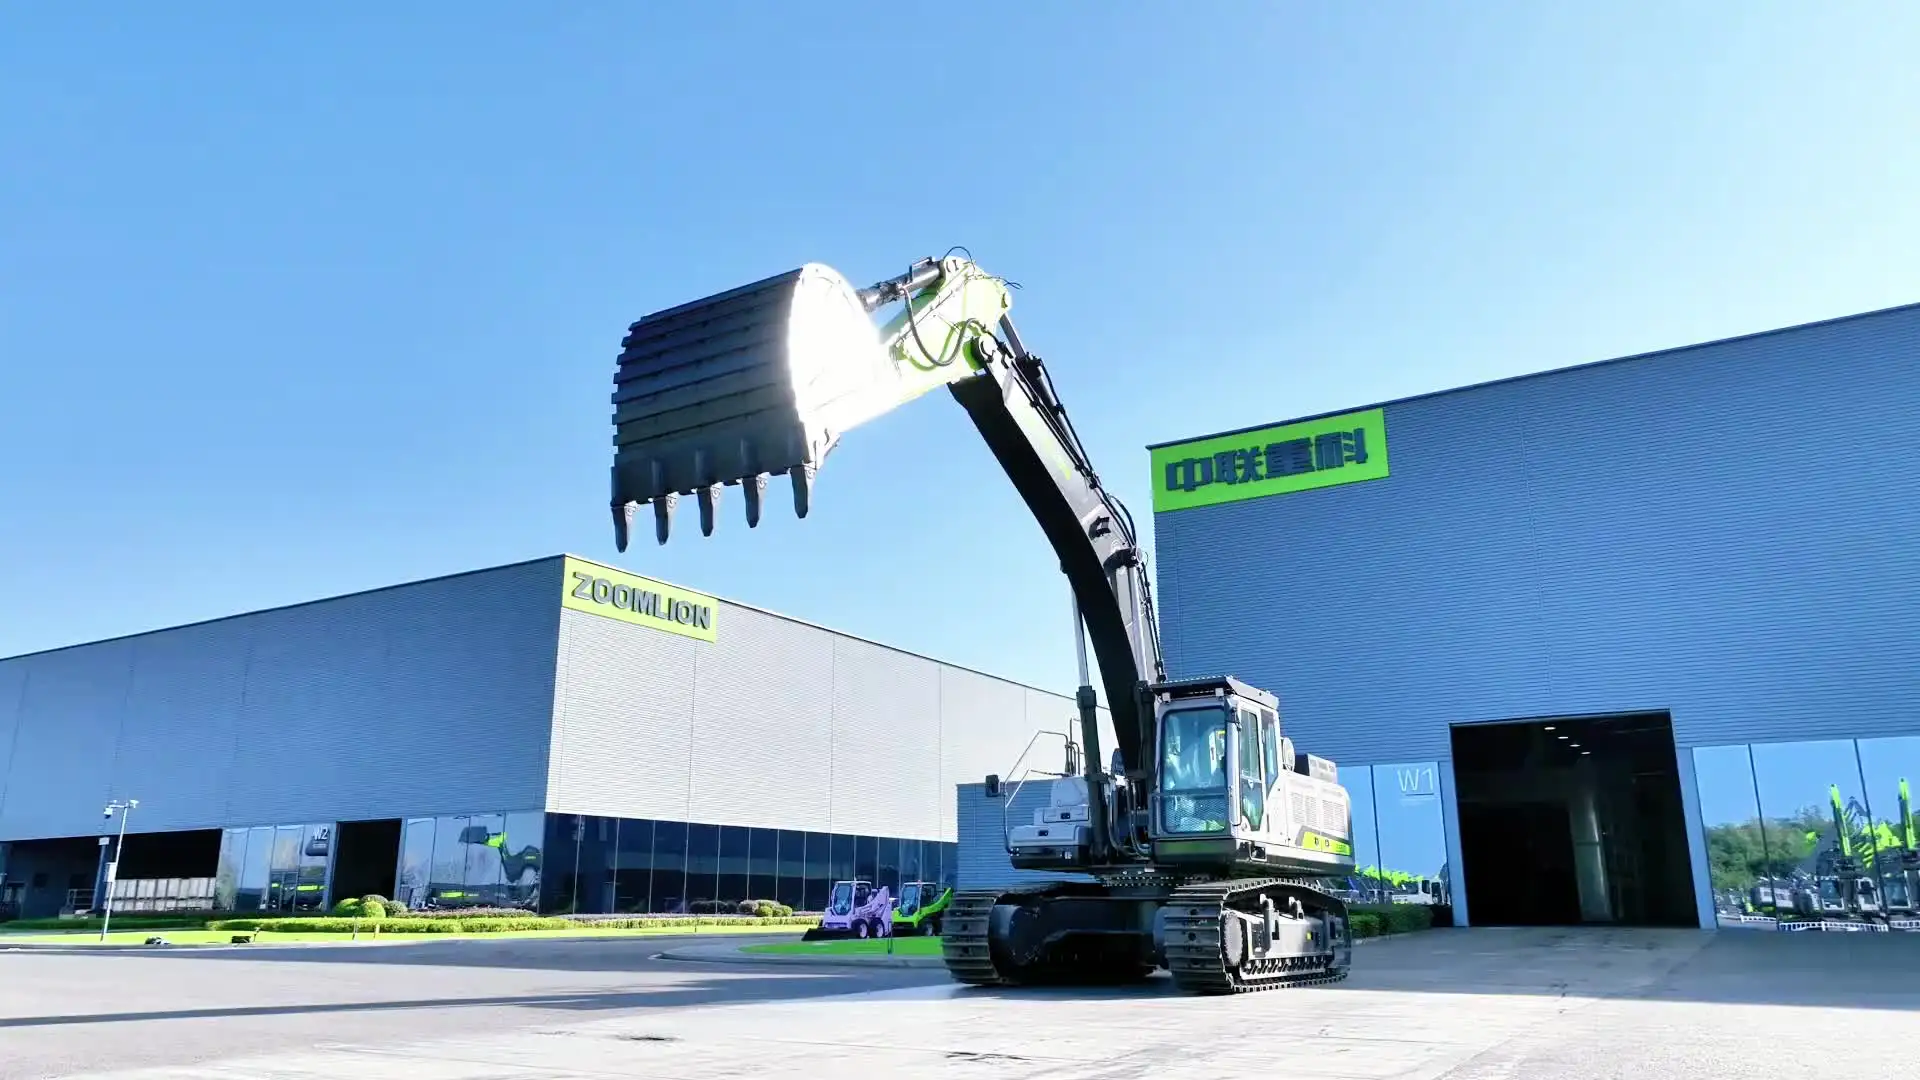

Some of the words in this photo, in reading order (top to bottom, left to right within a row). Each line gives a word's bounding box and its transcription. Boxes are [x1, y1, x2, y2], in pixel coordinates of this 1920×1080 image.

[1165, 428, 1368, 492] 中联重科
[572, 571, 711, 629] ZOOMLION
[1397, 768, 1433, 792] W1
[313, 826, 329, 841] W2
